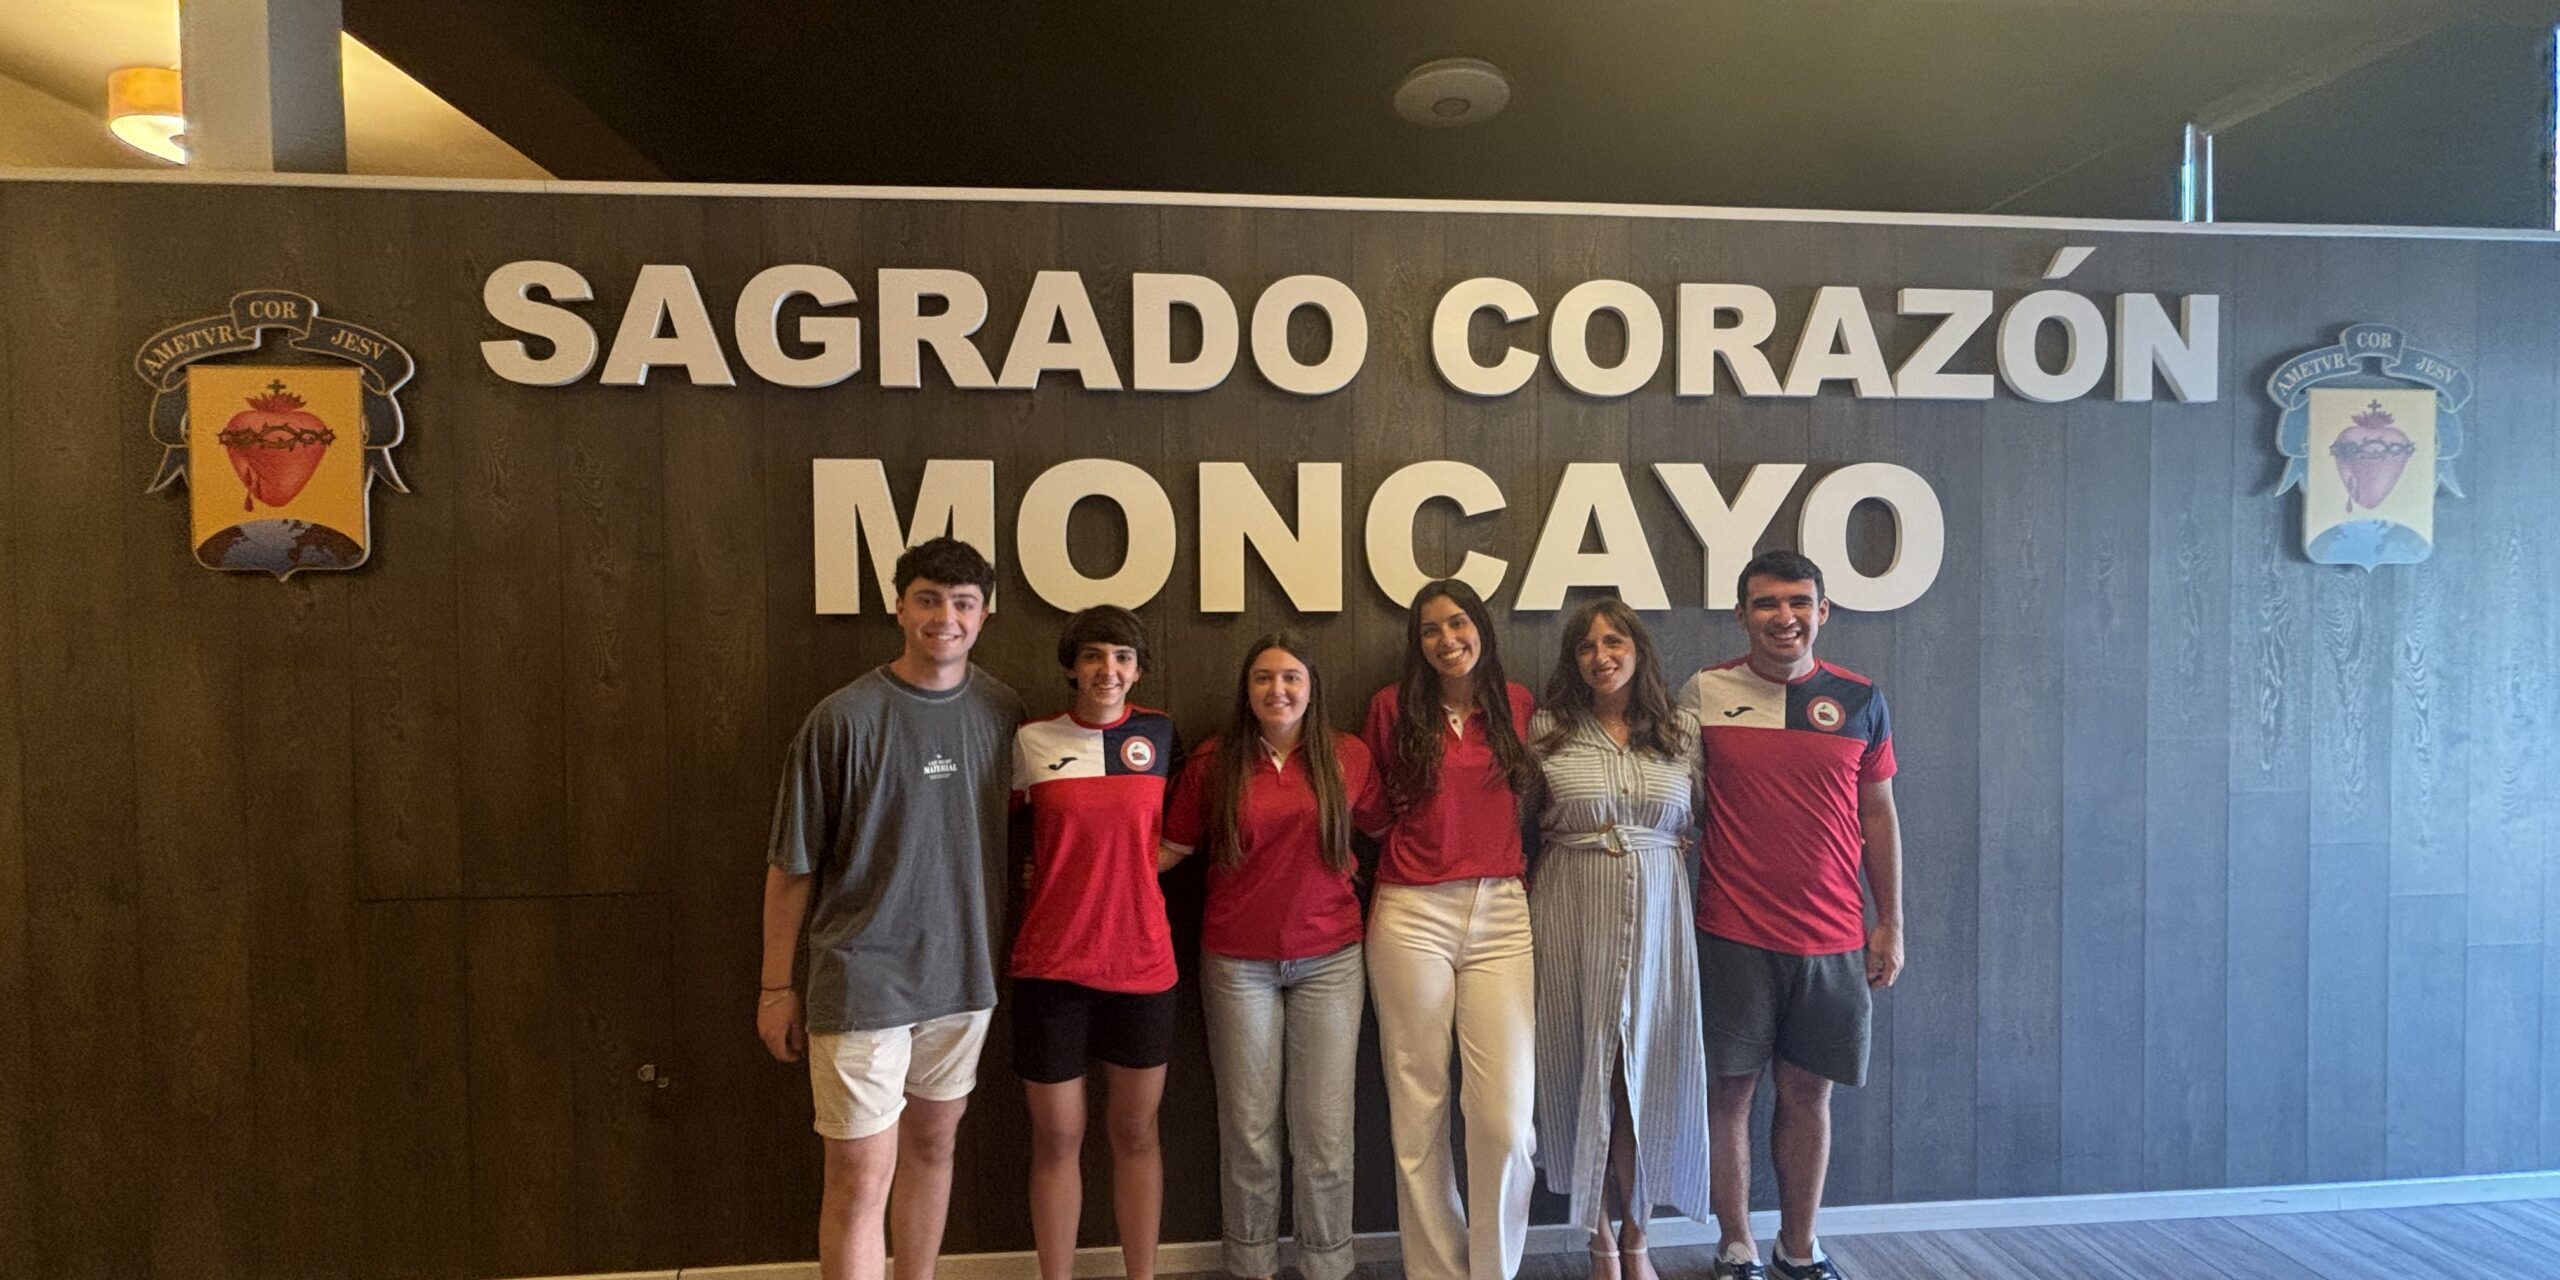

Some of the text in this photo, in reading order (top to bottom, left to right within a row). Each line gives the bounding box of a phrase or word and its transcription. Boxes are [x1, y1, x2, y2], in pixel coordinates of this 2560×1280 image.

[142, 300, 389, 376] AMETVR COR JESV
[480, 246, 2220, 403] SAGRADO CORAZÓN
[2276, 352, 2348, 397] AMETVR
[2356, 331, 2393, 349] COR
[813, 458, 1945, 615] MONCAYO
[923, 763, 958, 775] MATERIAL
